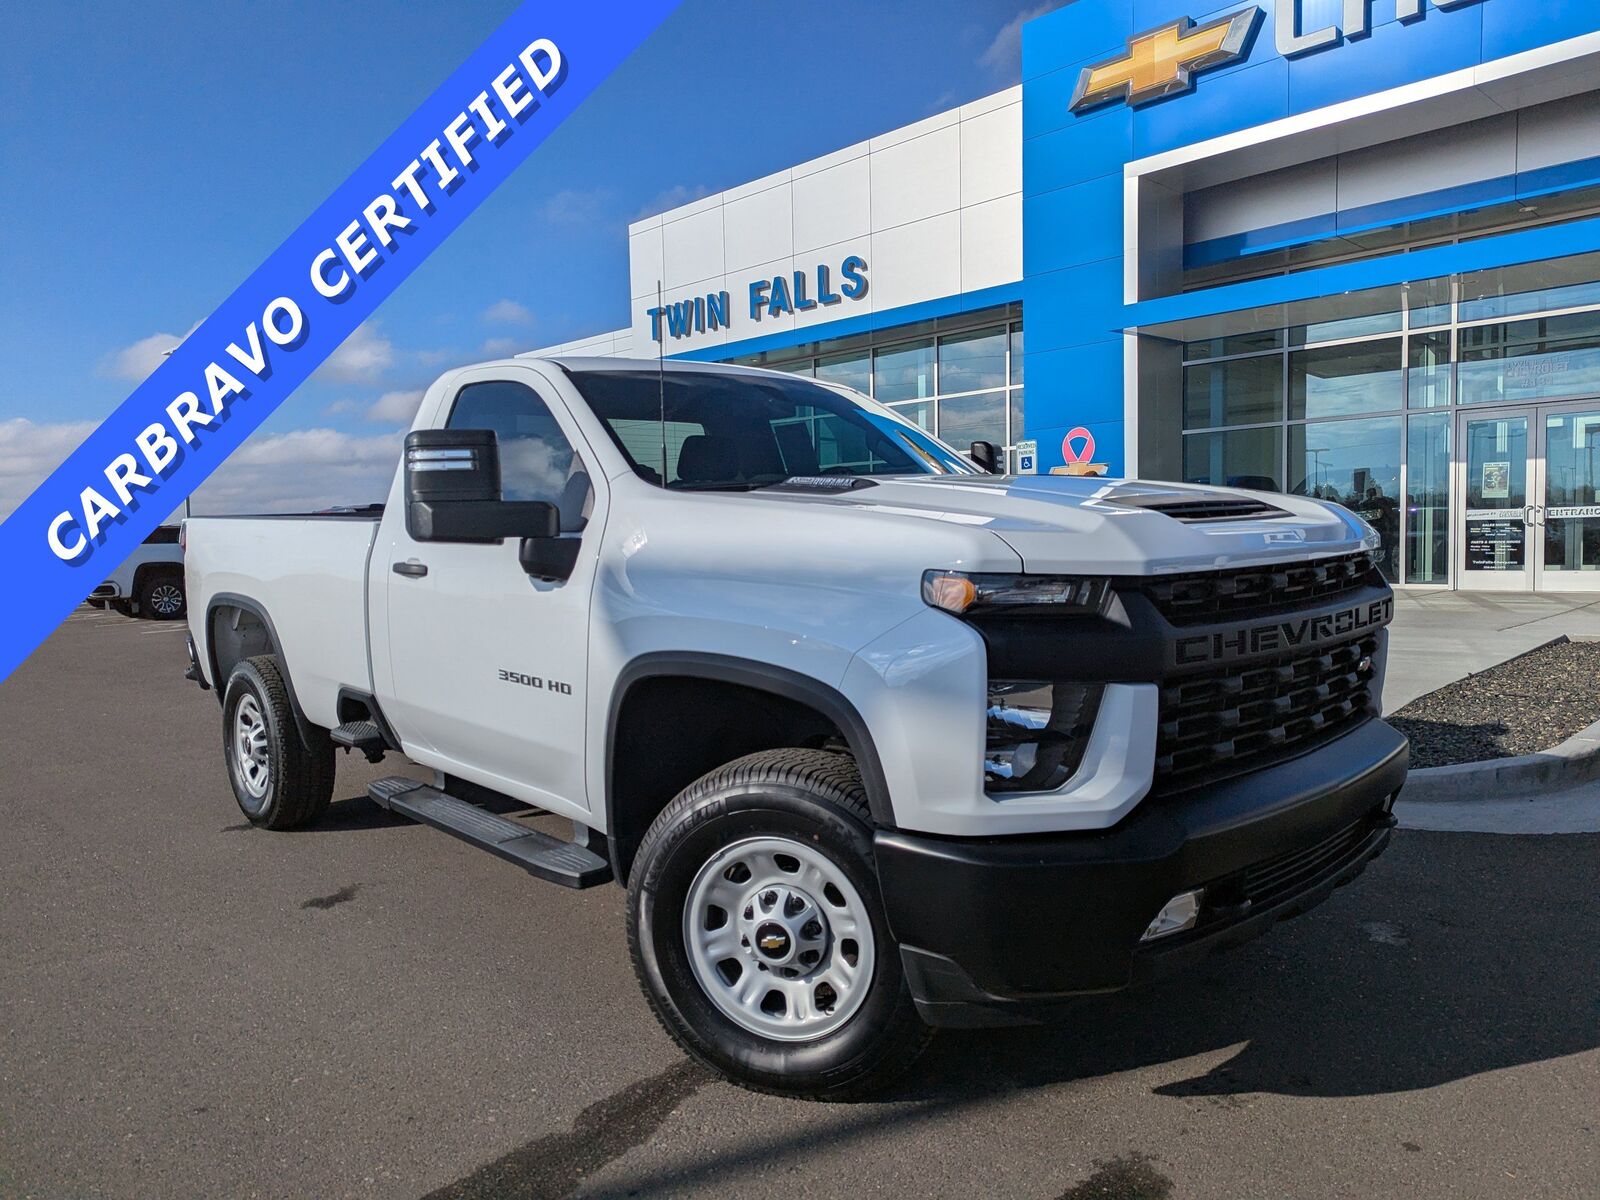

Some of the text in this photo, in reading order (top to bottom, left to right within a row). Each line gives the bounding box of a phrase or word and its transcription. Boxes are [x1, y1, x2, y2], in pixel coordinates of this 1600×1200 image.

[647, 255, 869, 344] TWIN FALLS
[1175, 597, 1392, 665] CHEVROLET
[498, 668, 572, 695] 3500 HD
